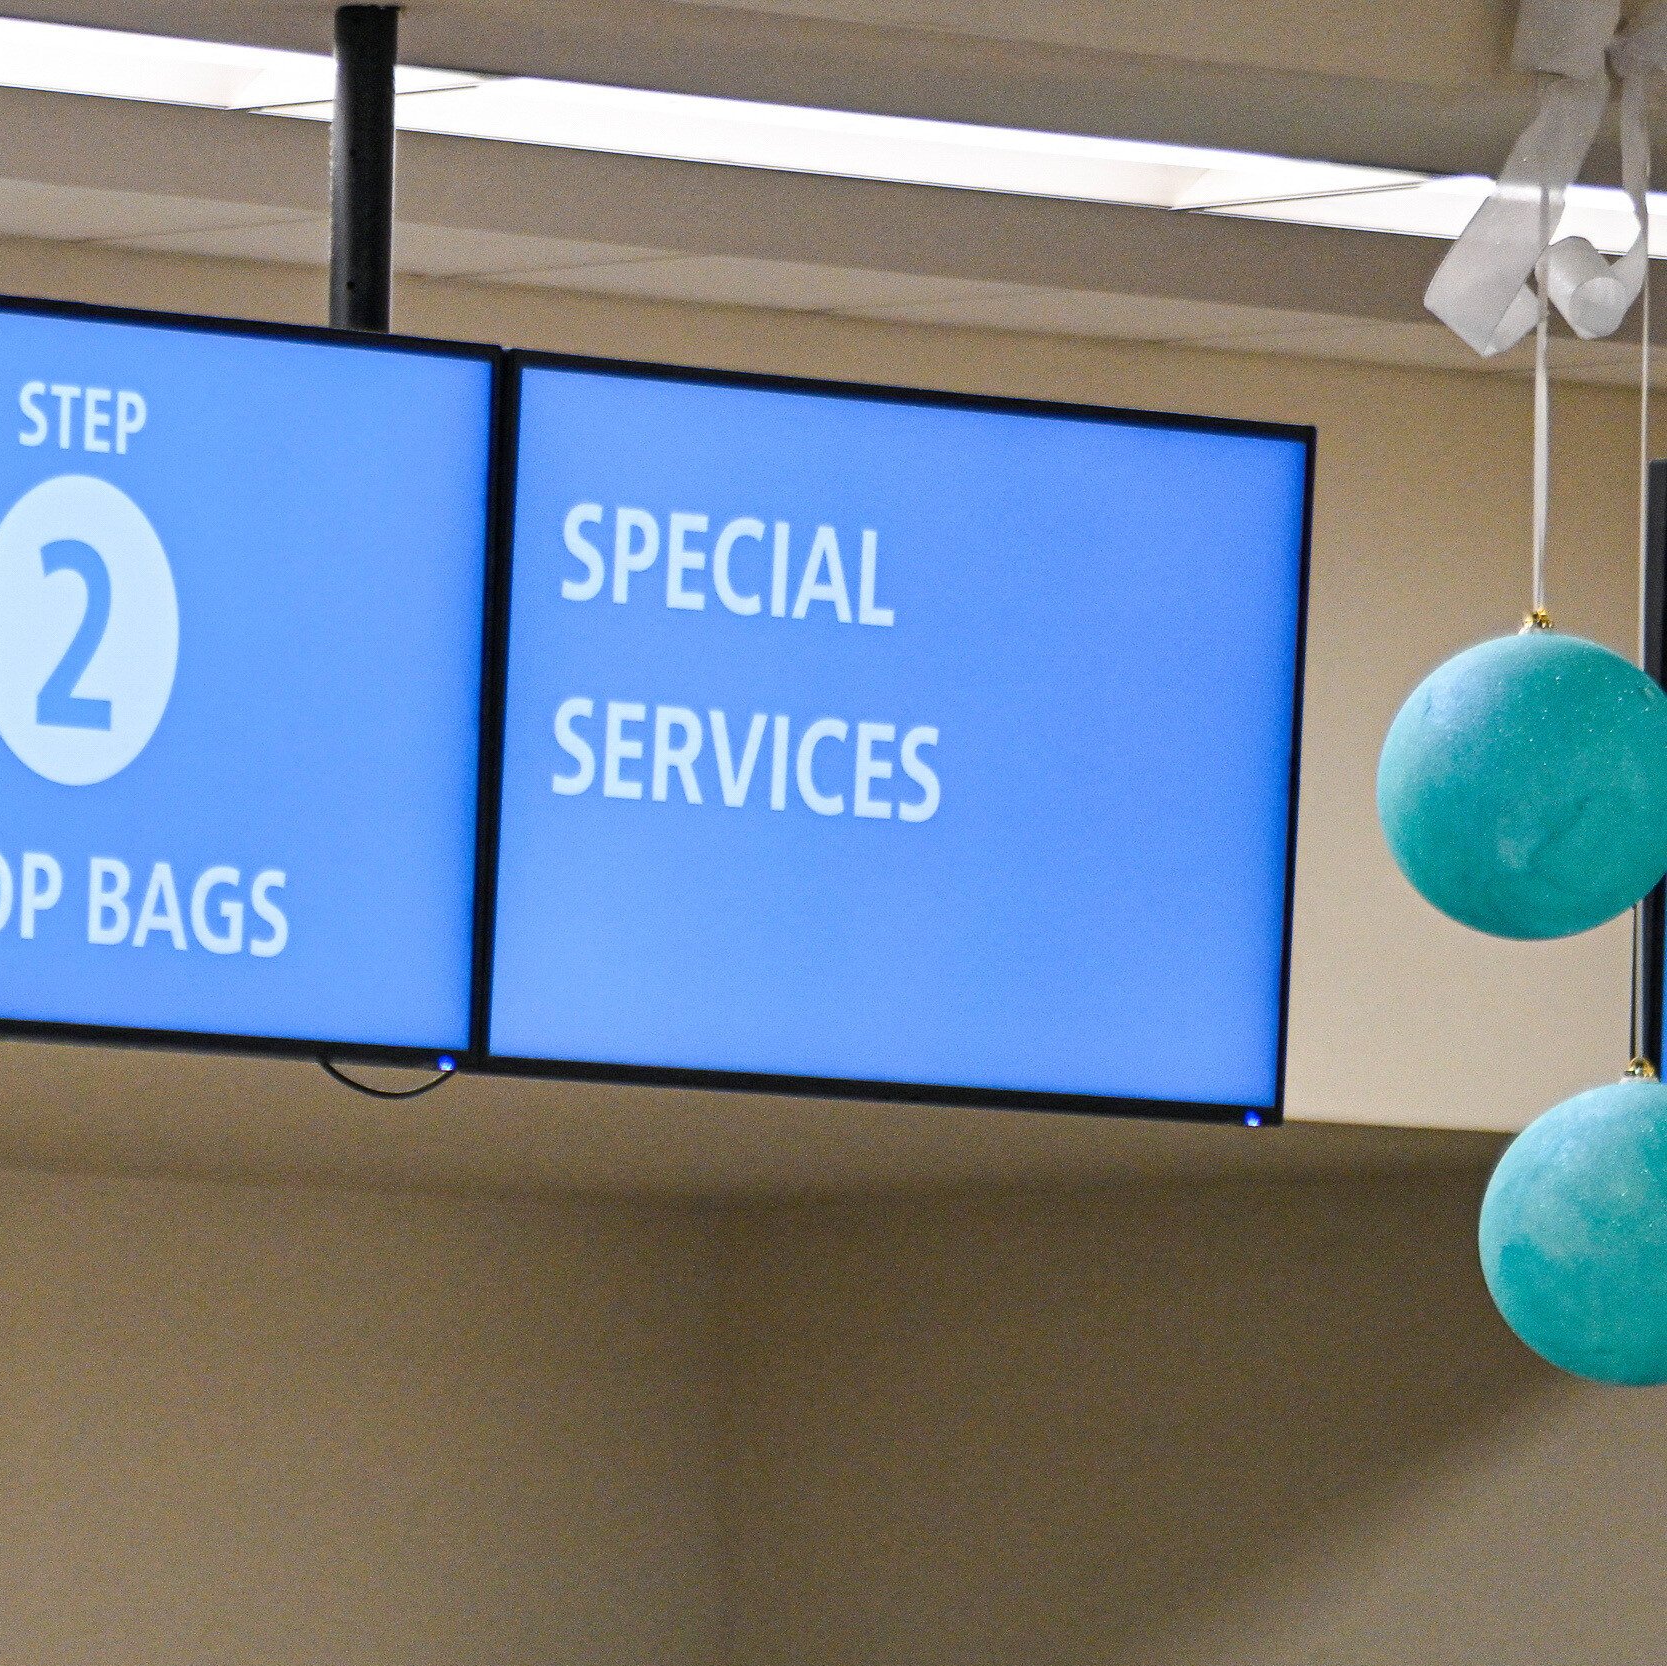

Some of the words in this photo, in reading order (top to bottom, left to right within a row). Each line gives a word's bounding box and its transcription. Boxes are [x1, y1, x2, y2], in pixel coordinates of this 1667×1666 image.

[19, 381, 147, 454] STEP
[562, 503, 894, 626] SPECIAL
[36, 539, 111, 730] 2
[552, 697, 940, 821] SERVICES
[88, 857, 288, 956] BAGS
